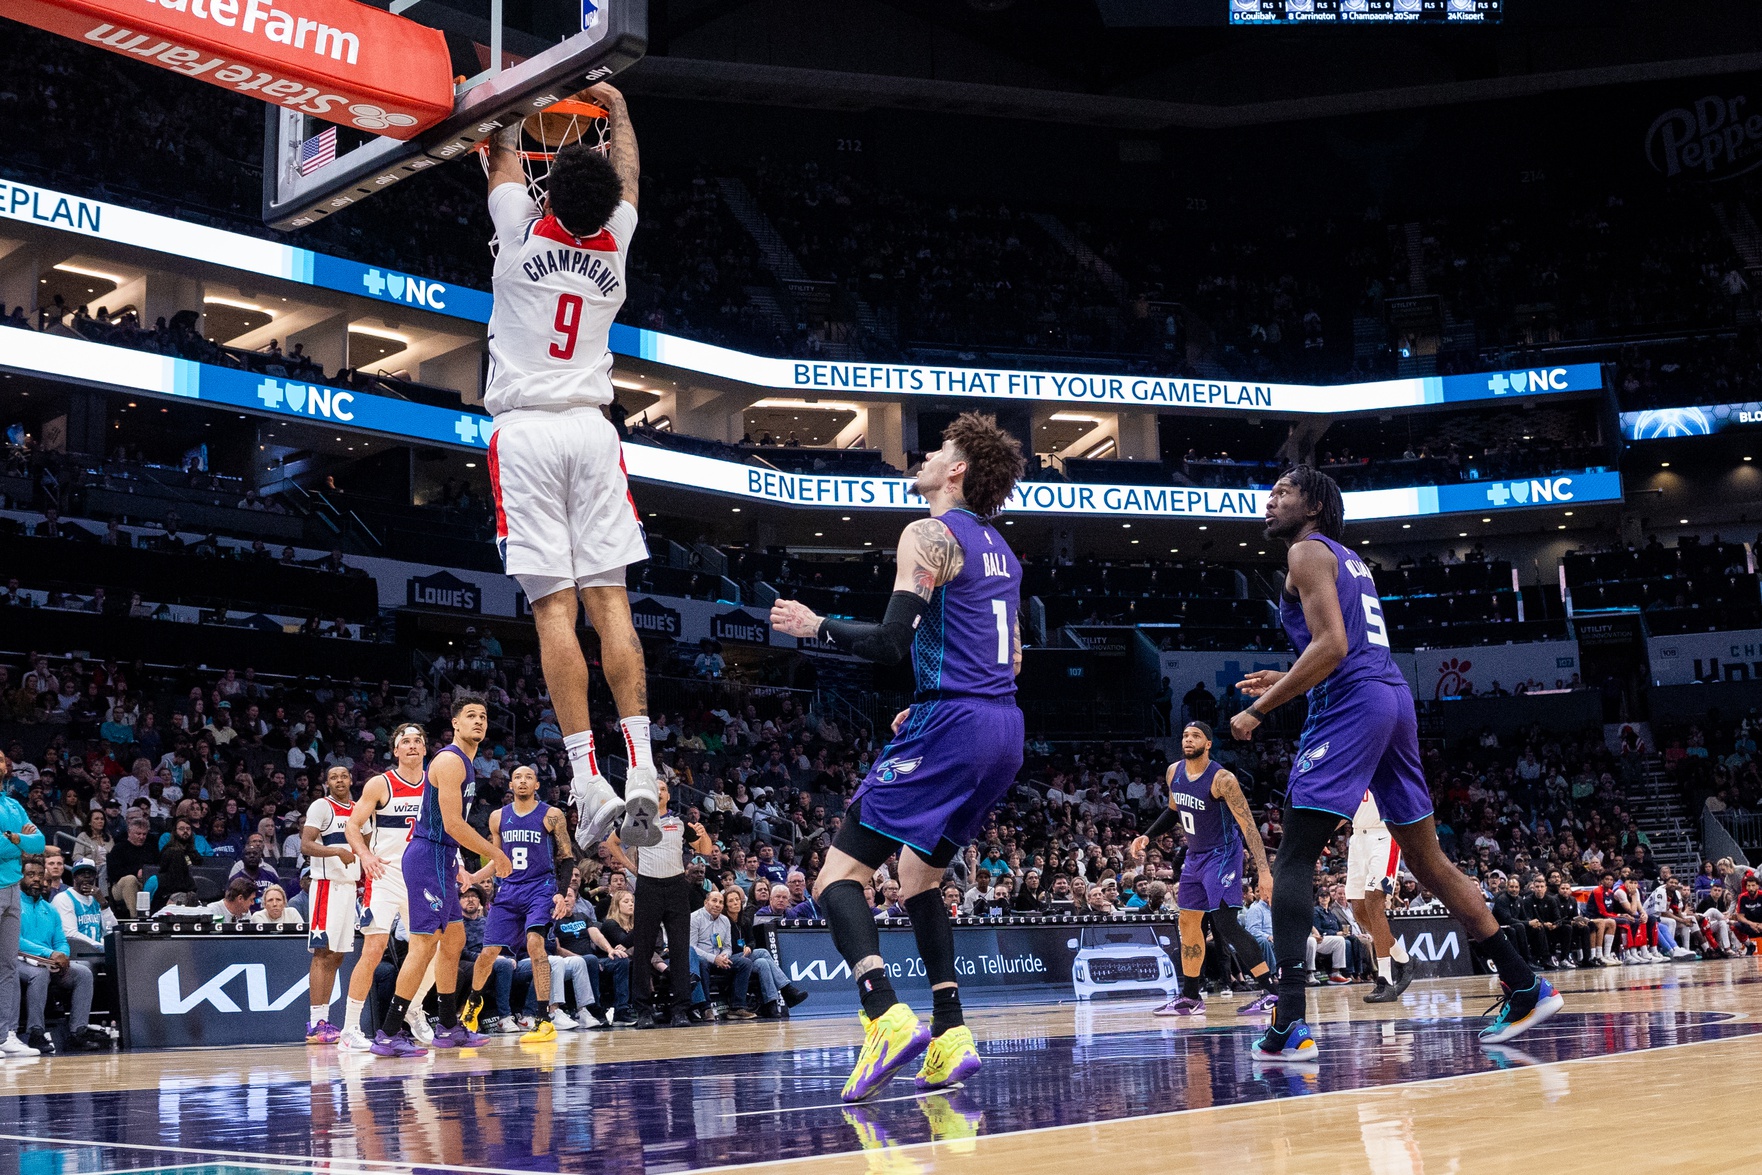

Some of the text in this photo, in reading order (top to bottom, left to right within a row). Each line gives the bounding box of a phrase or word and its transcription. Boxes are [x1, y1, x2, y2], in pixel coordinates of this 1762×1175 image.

[1241, 12, 1276, 20] Coulibaly
[1295, 12, 1336, 20] Carrington
[1349, 12, 1394, 20] Champagnie
[586, 64, 613, 81] ally
[532, 92, 559, 108] ally
[477, 118, 503, 134] ally
[1694, 95, 1747, 139] Dr
[440, 140, 465, 157] ally
[836, 139, 863, 152] 212
[411, 157, 436, 170] ally
[375, 173, 400, 186] ally
[331, 195, 354, 208] ally
[292, 215, 314, 227] ally
[523, 249, 620, 297] CHAMPAGNIE
[406, 274, 446, 310] NC
[547, 292, 583, 360] 9
[794, 363, 1273, 407] BENEFITS THAT FIT YOUR GAMEPLAN
[1528, 368, 1568, 392] NC
[307, 388, 355, 422] NC
[747, 469, 875, 504] BENEFITS
[1020, 486, 1093, 510] YOUR
[1103, 488, 1257, 515] GAMEPLAN
[1531, 477, 1574, 502] NC
[982, 552, 1010, 578] BALL
[414, 582, 474, 609] LOWE'S
[633, 612, 675, 633] OWE'S
[716, 619, 764, 643] LOWE'S
[1361, 593, 1390, 648] 5
[1580, 624, 1613, 634] UTILITY
[991, 599, 1009, 664] 1
[1730, 644, 1762, 657] CH
[1069, 668, 1082, 676] 107
[394, 802, 419, 813] wiza
[1171, 792, 1206, 811] HORNETS
[1180, 810, 1196, 835] 0
[501, 829, 542, 844] HORNETS
[512, 847, 528, 870] 8
[790, 960, 852, 981] KIA
[953, 959, 976, 976] Kia
[978, 953, 1047, 974] Telluride.
